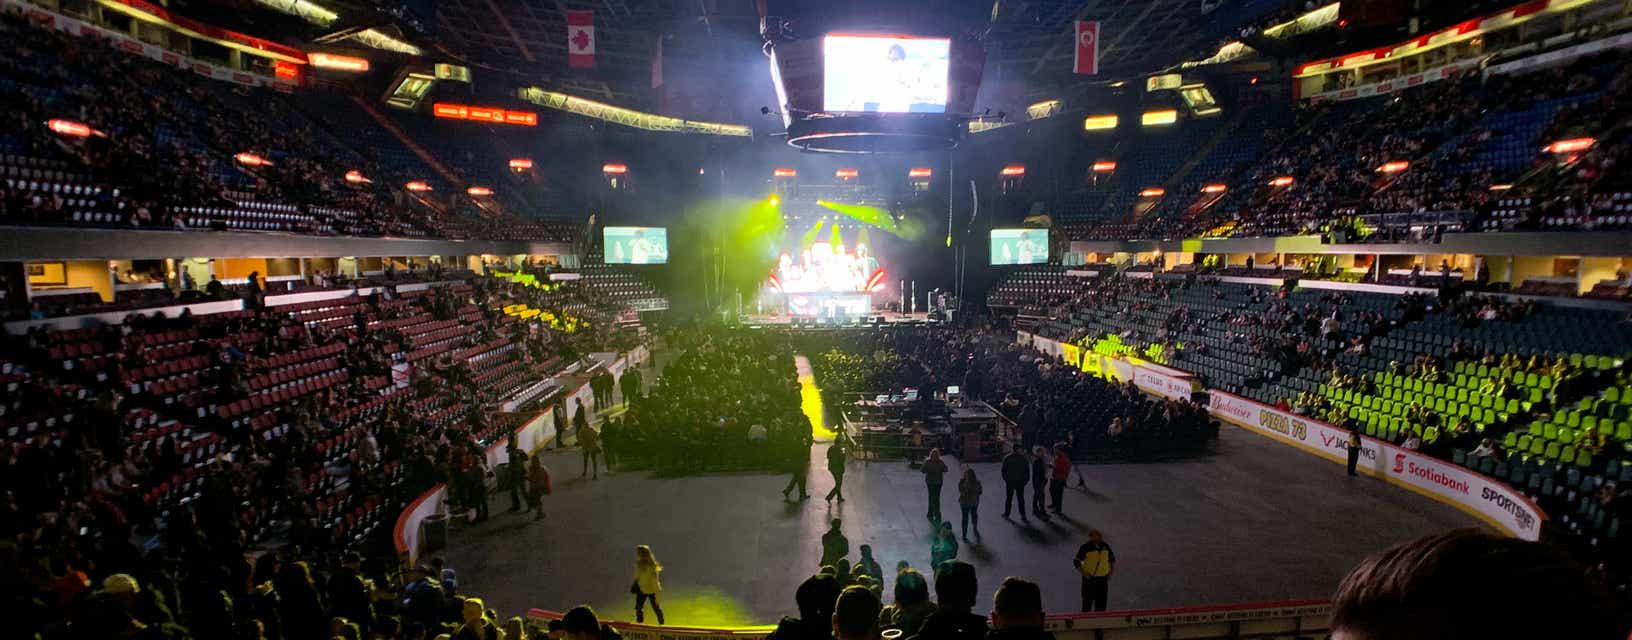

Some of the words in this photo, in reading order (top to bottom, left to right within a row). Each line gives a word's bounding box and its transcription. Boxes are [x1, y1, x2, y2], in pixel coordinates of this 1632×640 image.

[1213, 395, 1252, 418] Budweiser
[1259, 409, 1290, 435] PIZZA
[1292, 419, 1307, 440] 73
[1408, 462, 1470, 495] Scotiabank
[1481, 487, 1536, 531] SPORTSNET
